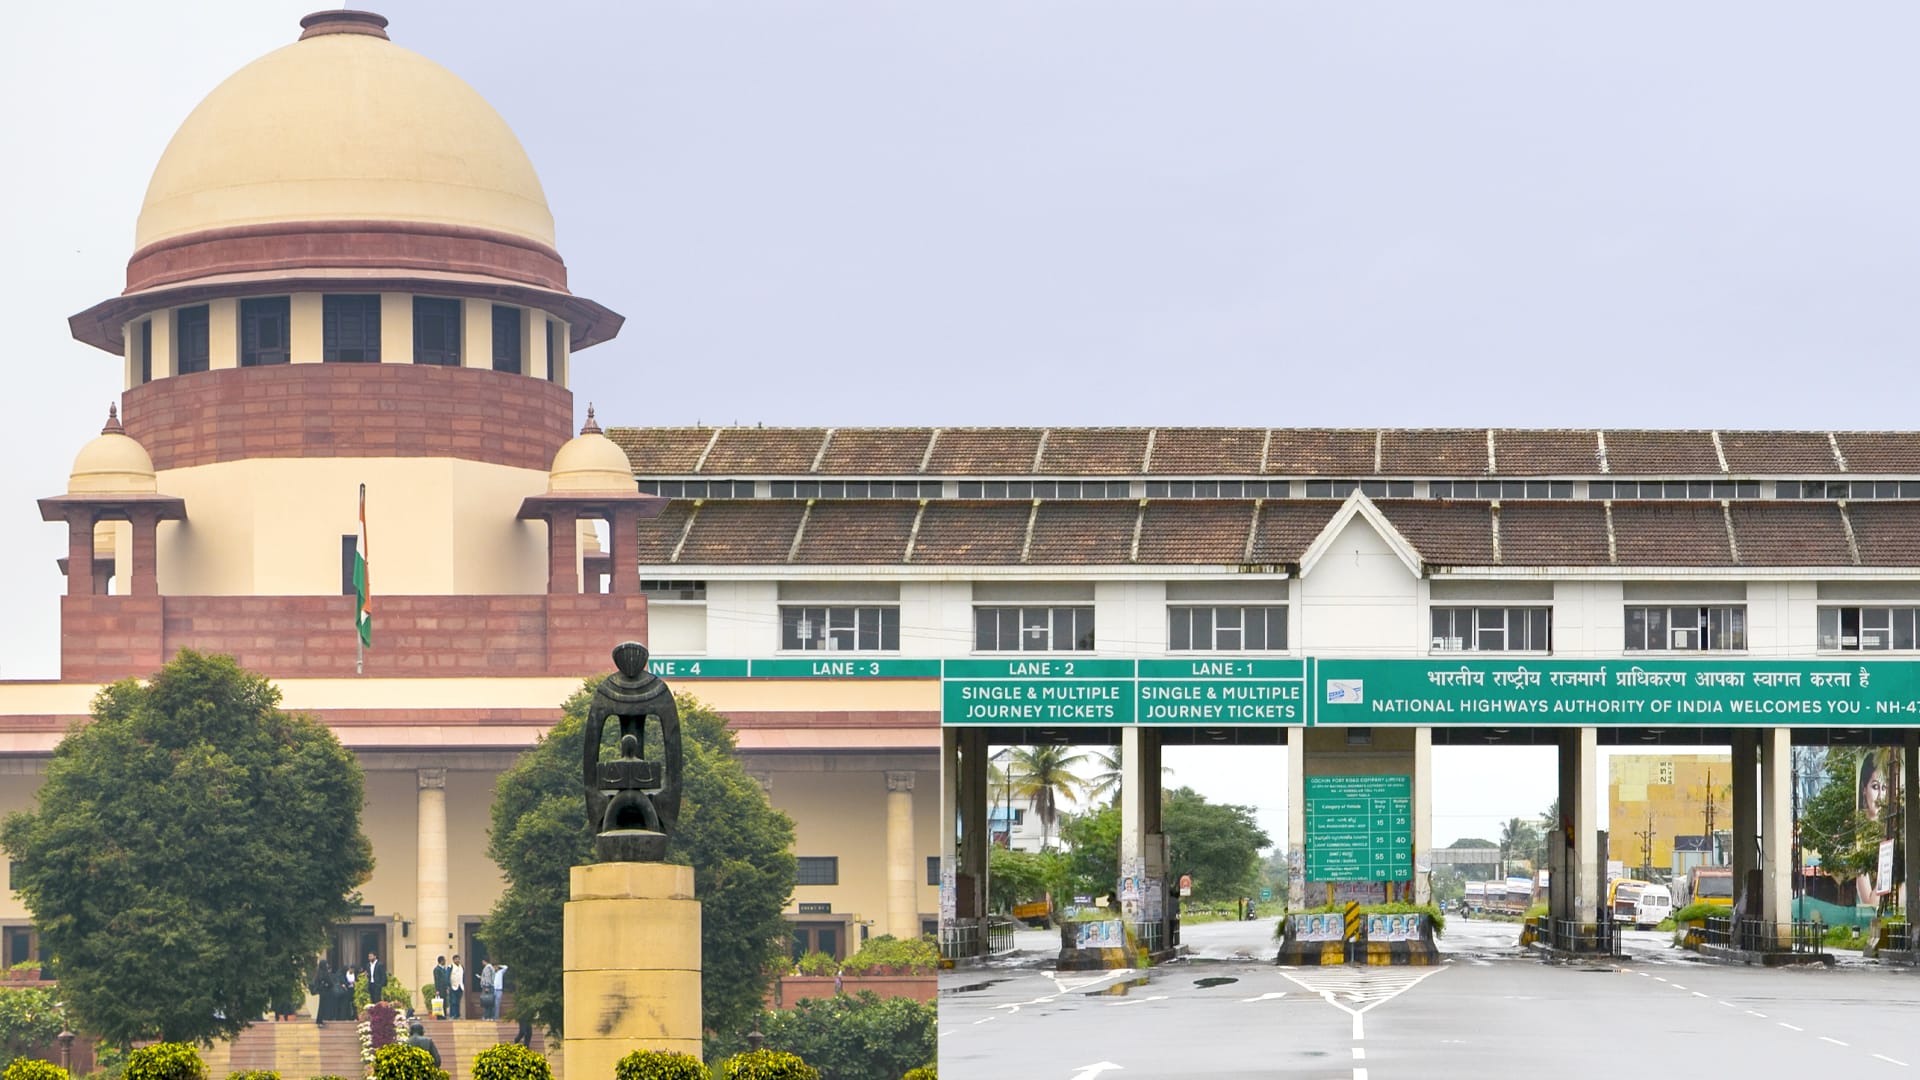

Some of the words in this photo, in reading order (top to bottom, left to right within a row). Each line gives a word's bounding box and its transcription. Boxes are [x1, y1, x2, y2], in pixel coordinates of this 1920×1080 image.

[648, 662, 676, 675] NE
[690, 663, 701, 675] 4
[812, 663, 855, 675] LANE
[869, 663, 880, 675] 3
[1009, 663, 1051, 676] LANE
[1065, 663, 1076, 676] 2
[1192, 663, 1234, 675] LANE
[1246, 663, 1253, 675] 1
[1427, 665, 1485, 686] भारतीय
[1491, 665, 1541, 690] राष्ट्रीय
[1550, 665, 1607, 687] राजमार्ग
[1616, 665, 1687, 687] प्राधिकरण
[1694, 671, 1746, 687] आपका
[1753, 672, 1802, 688] स्वागत
[1810, 672, 1852, 688] करता
[1858, 666, 1871, 688] है
[962, 687, 1022, 700] SINGLE
[1026, 687, 1038, 700] &
[1043, 687, 1120, 700] MULTIPLE
[1141, 687, 1201, 700] SINGLE
[1206, 687, 1217, 700] &
[1223, 687, 1299, 700] MULTIPLE
[966, 705, 1043, 718] JOURNEY
[1048, 705, 1114, 718] TICKETS
[1146, 705, 1223, 718] JOURNEY
[1228, 705, 1295, 718] TICKETS
[1372, 699, 1454, 712] NATIONAL
[1460, 699, 1549, 713] HIGHWAYS
[1553, 699, 1645, 713] AUTHORITY
[1650, 699, 1672, 713] OF
[1677, 700, 1723, 713] INDIA
[1730, 700, 1822, 713] WELCOMES
[1828, 700, 1861, 713] YOU
